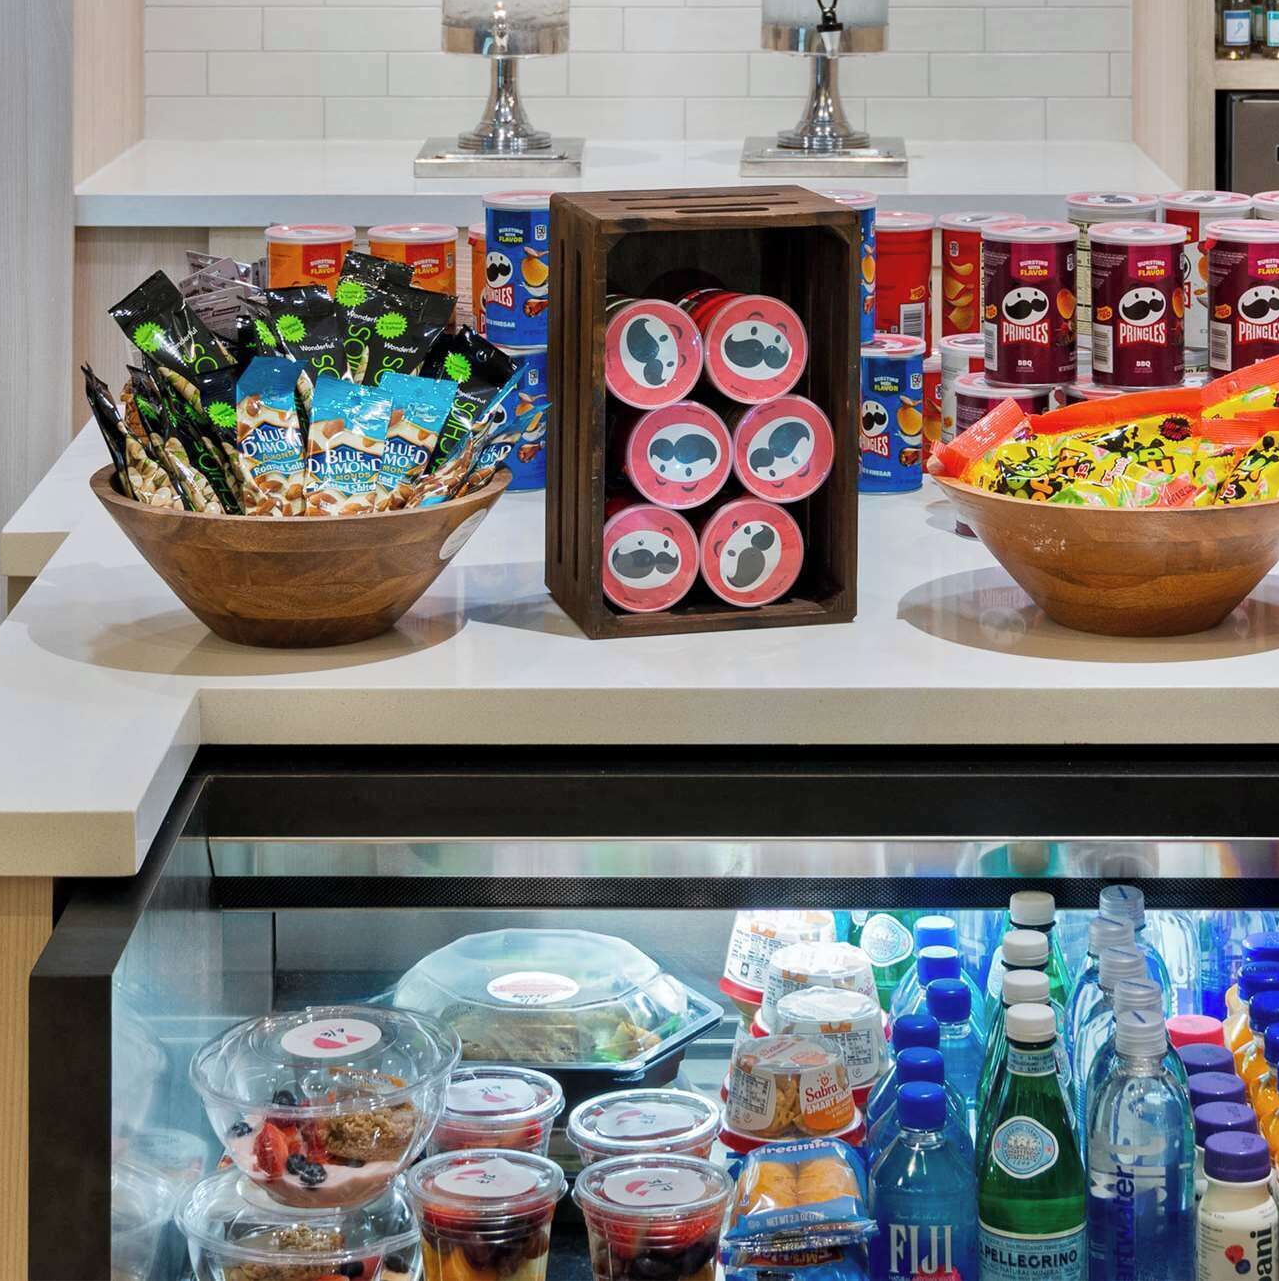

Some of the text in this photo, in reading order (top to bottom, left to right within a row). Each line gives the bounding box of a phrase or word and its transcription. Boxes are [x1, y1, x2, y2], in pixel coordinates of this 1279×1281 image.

[1019, 269, 1048, 277] FLAVOR
[1138, 269, 1165, 277] FLAVOR
[347, 310, 378, 323] Wonderf
[1002, 321, 1049, 344] PRINGLES
[1119, 322, 1166, 345] PRINGLES
[299, 343, 335, 352] Wonderful
[384, 342, 419, 354] Wonderful
[1017, 360, 1033, 368] BBQ
[1136, 360, 1151, 368] BBQ
[256, 427, 287, 443] BLUE
[326, 449, 364, 465] BLUE
[285, 461, 305, 470] Salt
[308, 458, 383, 474] DIAMOND
[805, 1082, 838, 1103] Sabra
[889, 1223, 953, 1275] FIJI
